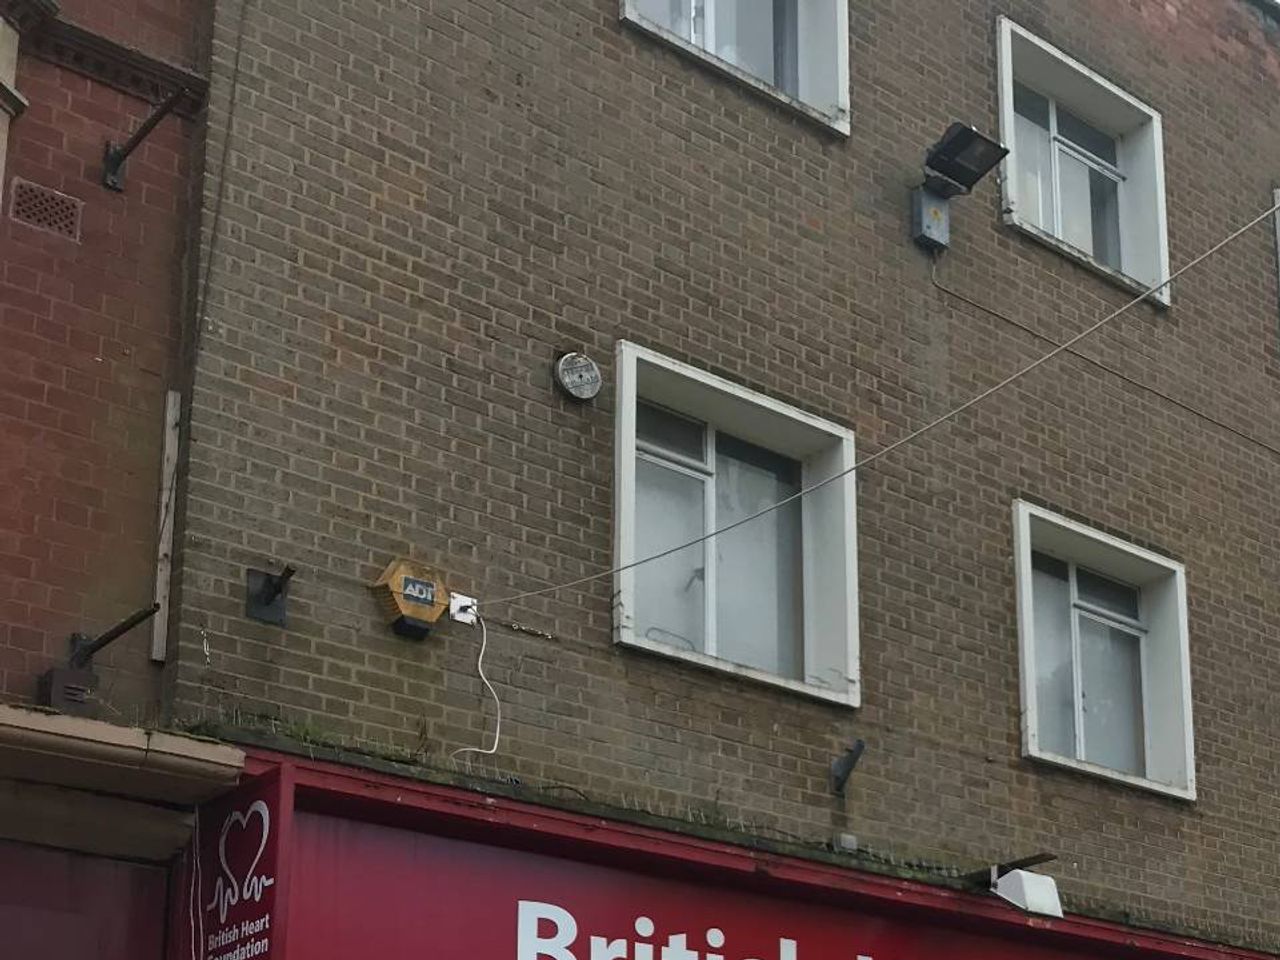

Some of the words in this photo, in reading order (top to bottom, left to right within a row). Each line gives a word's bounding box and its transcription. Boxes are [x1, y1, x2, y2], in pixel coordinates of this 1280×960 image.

[403, 582, 433, 601] ADT
[207, 924, 239, 951] British
[241, 913, 270, 938] Heart
